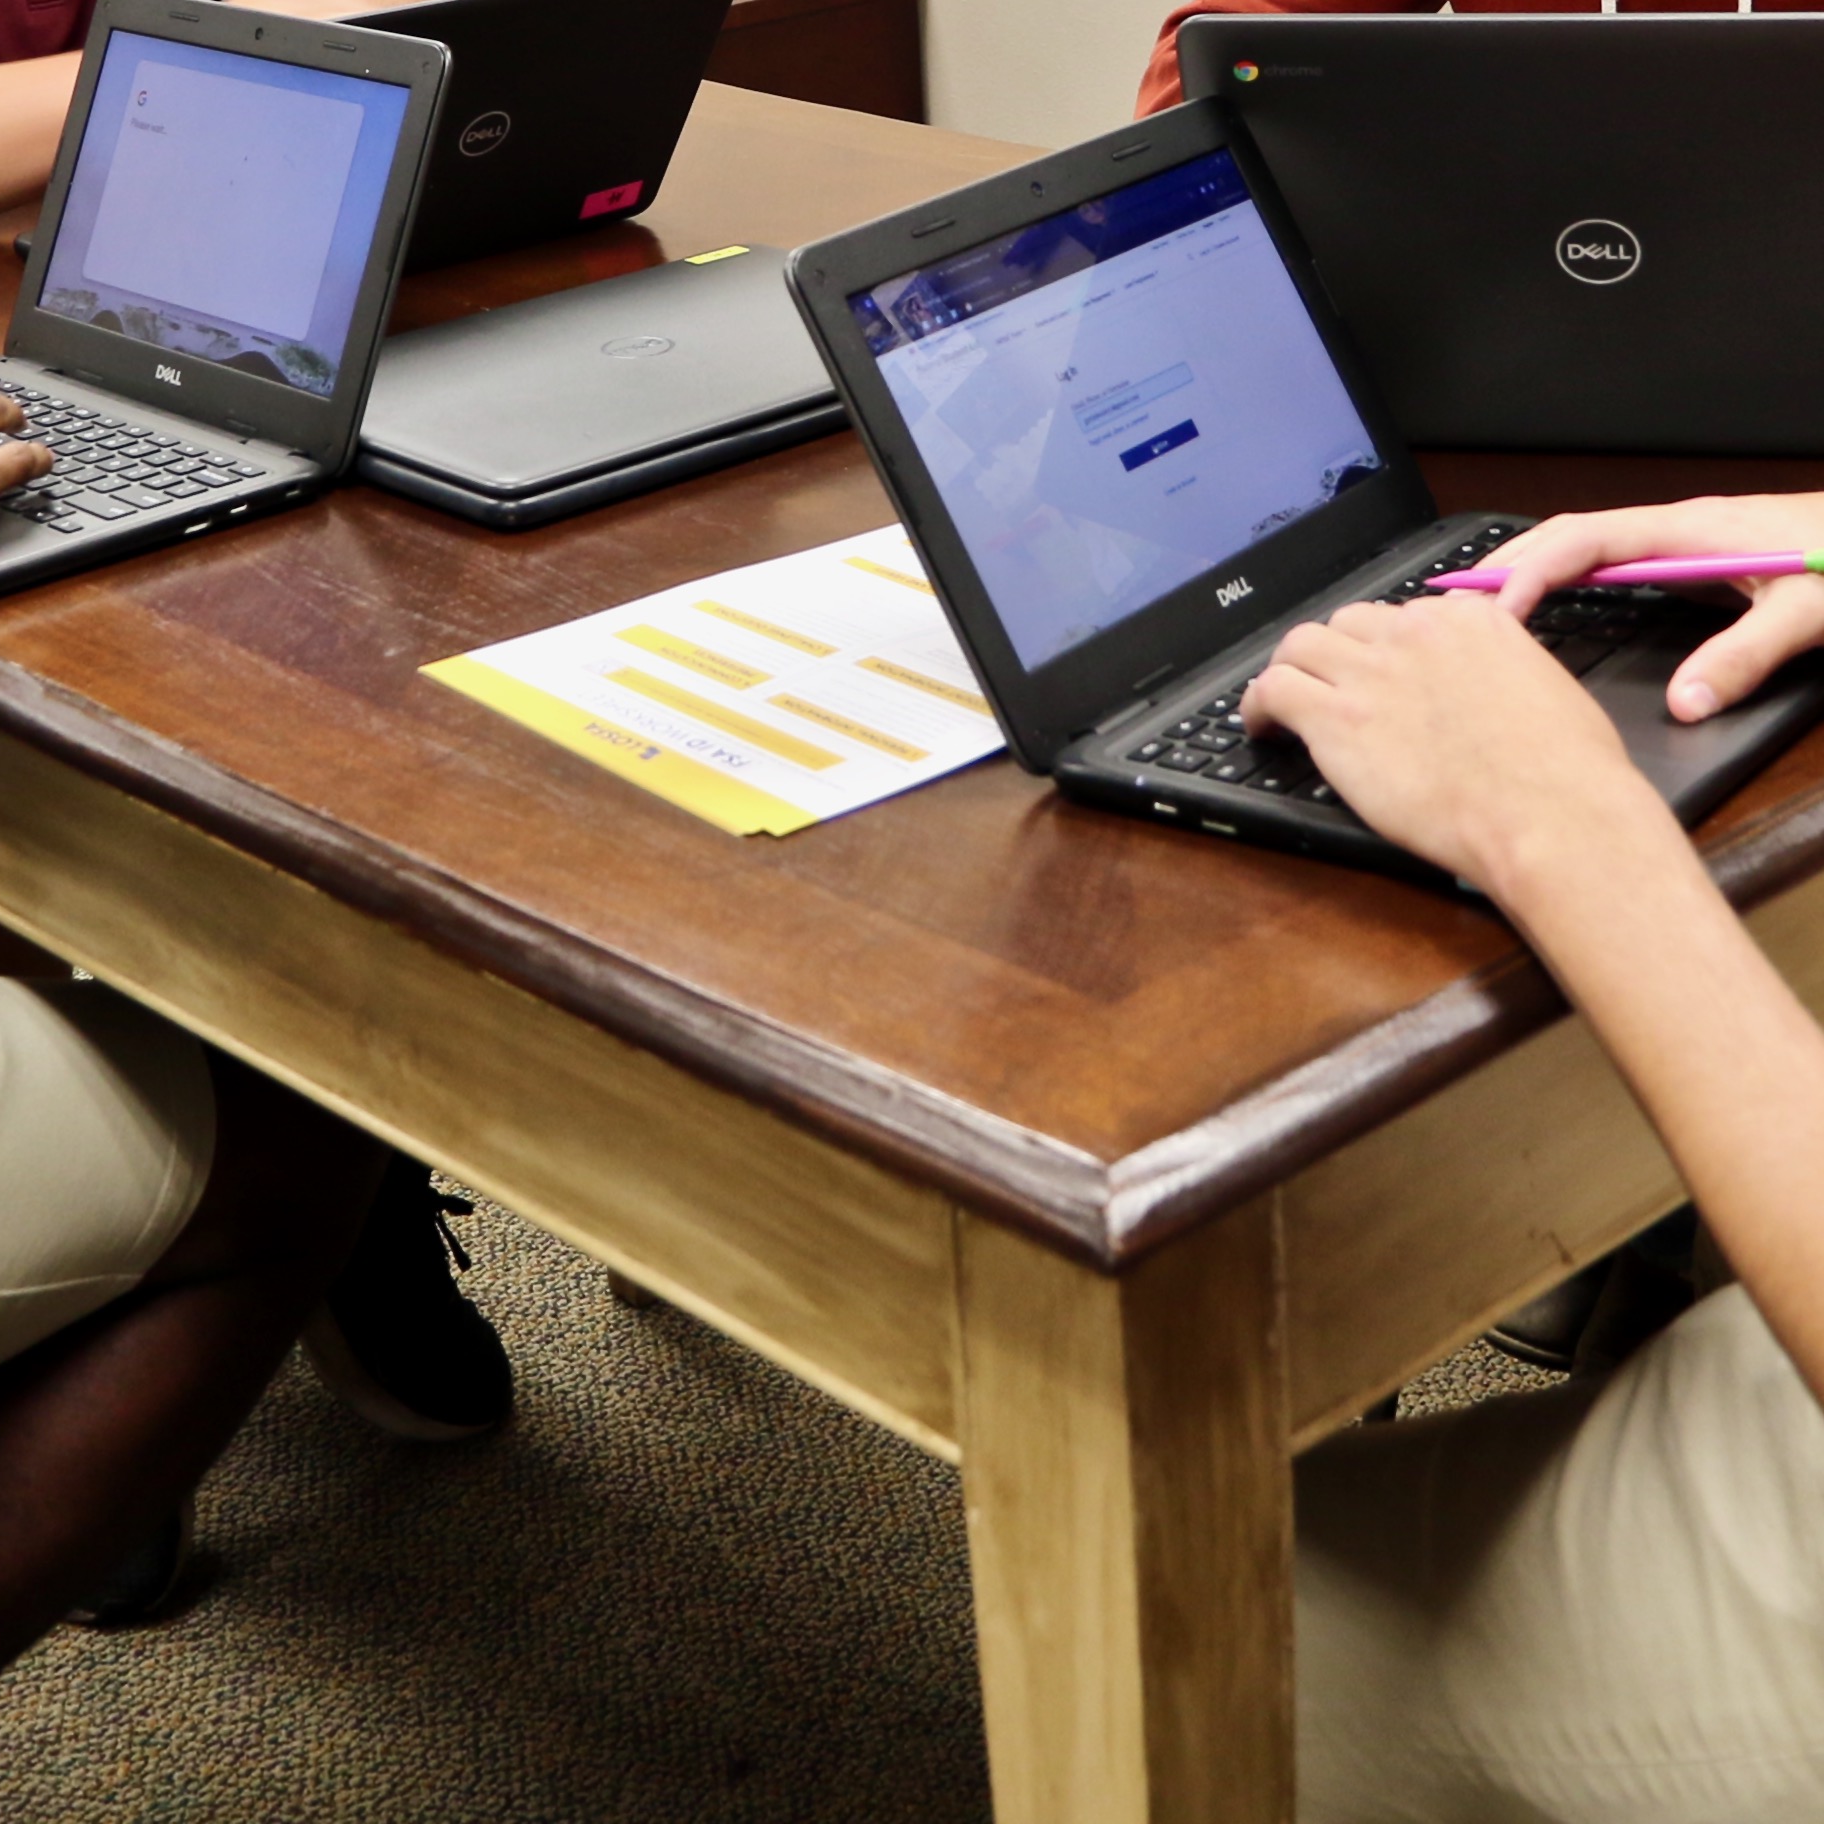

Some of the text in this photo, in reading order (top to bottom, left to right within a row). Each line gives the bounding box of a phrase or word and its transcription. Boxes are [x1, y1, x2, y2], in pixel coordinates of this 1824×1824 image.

[466, 126, 503, 143] DELL
[1567, 243, 1633, 260] DELL
[155, 364, 182, 386] DELL
[1216, 576, 1254, 607] DELL
[709, 747, 752, 770] FSA
